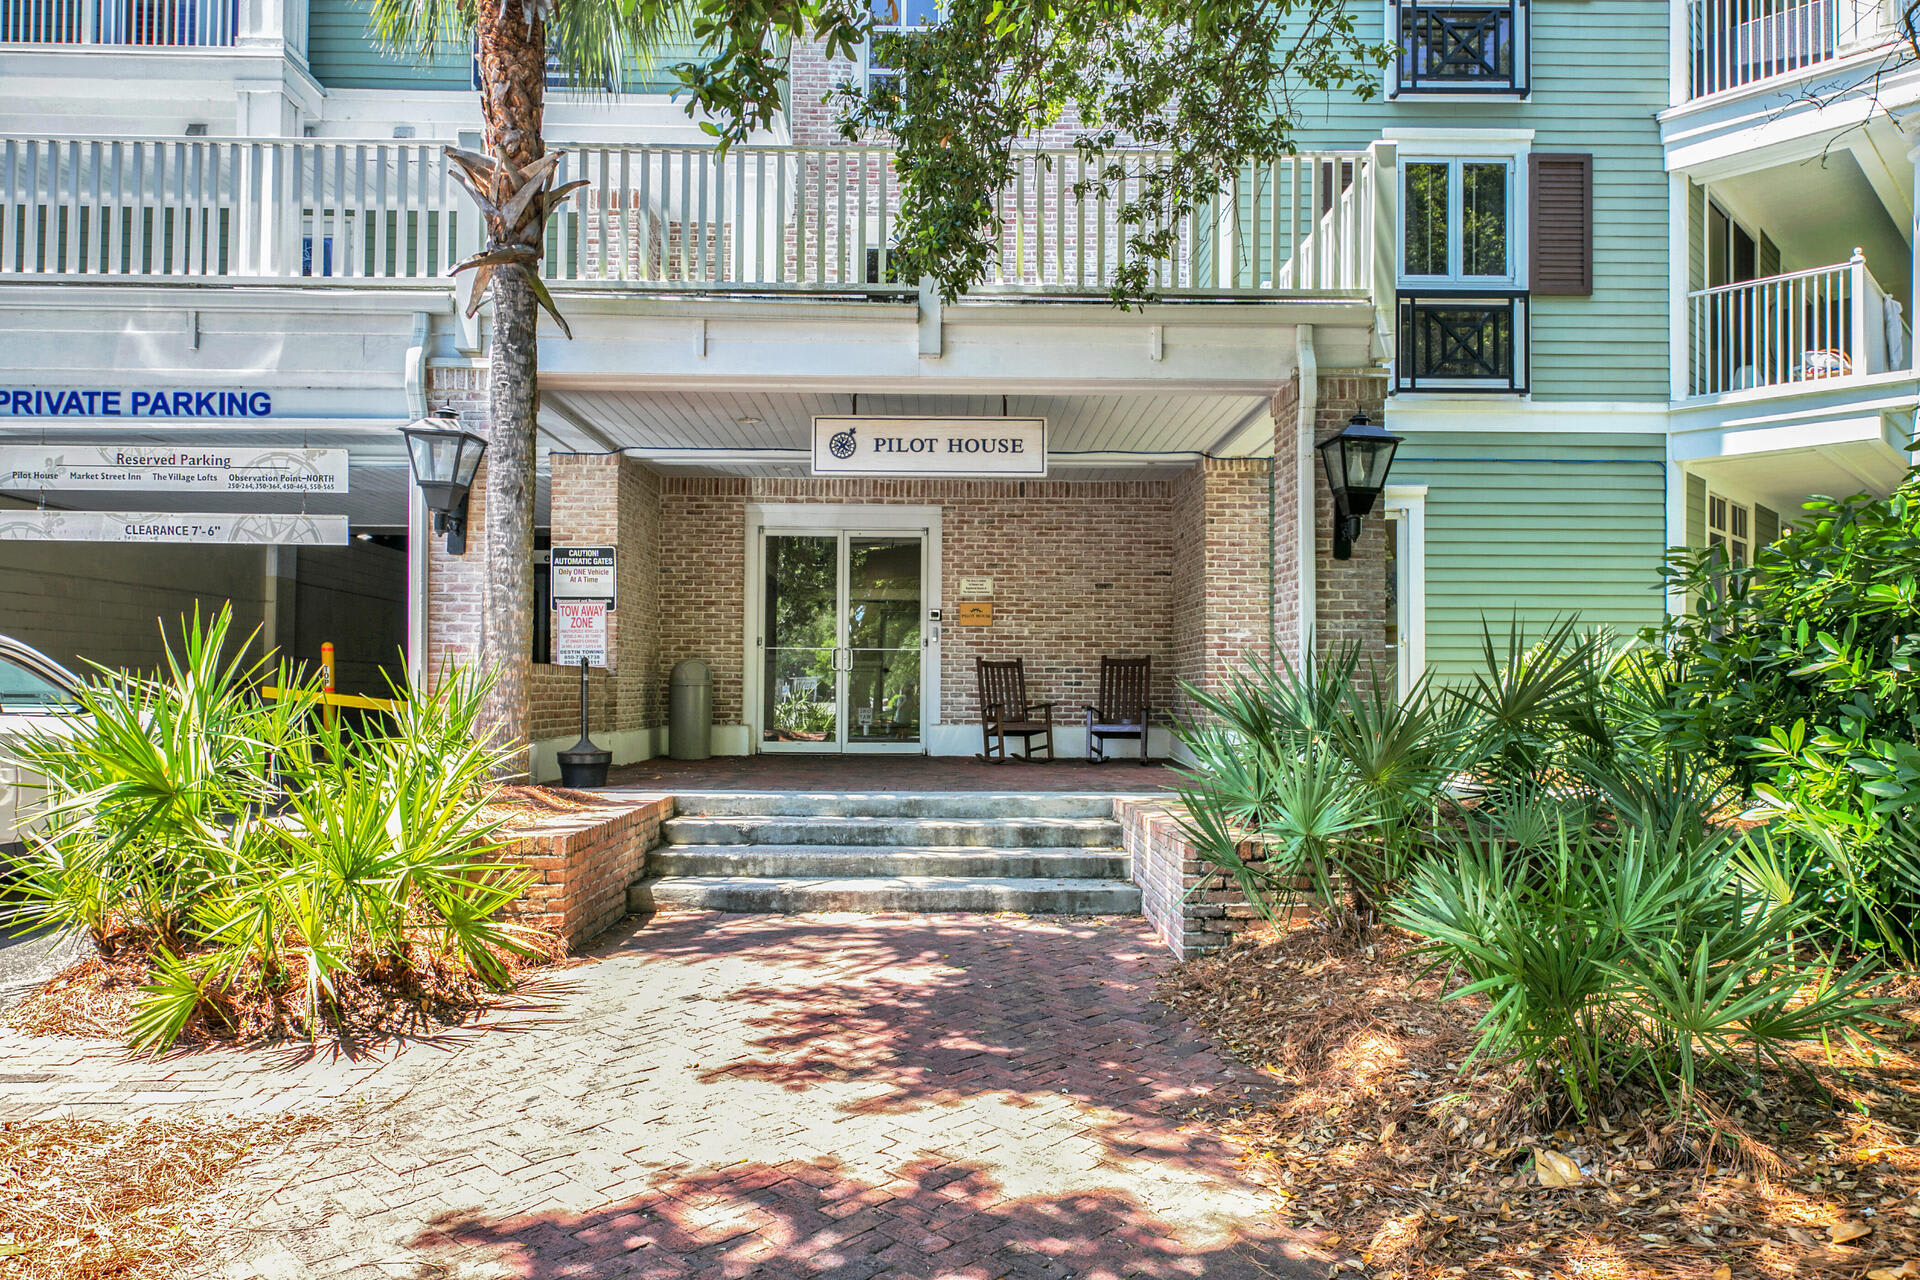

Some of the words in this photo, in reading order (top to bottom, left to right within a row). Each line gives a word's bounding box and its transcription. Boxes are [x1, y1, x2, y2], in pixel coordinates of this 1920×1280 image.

[0, 391, 121, 416] PRIVATE
[131, 391, 271, 416] PARKING
[873, 437, 938, 452] PILOT
[947, 438, 1024, 453] HOUSE
[117, 453, 176, 465] Reserved
[180, 454, 231, 469] Parking
[12, 471, 31, 480] Pilot
[33, 471, 59, 480] House
[69, 472, 99, 481] Market
[100, 472, 126, 481] Street
[128, 473, 142, 481] Inn
[152, 473, 166, 481] The
[168, 473, 195, 483] Village
[197, 473, 218, 482] Lofts
[228, 474, 277, 482] Observation
[125, 524, 189, 536] CLEARANCE
[554, 557, 592, 565] AUTOMATIC
[592, 557, 613, 565] GATES
[558, 568, 572, 576] Only
[560, 605, 579, 616] TOW
[580, 605, 604, 616] AWAY
[570, 617, 593, 628] ZONE
